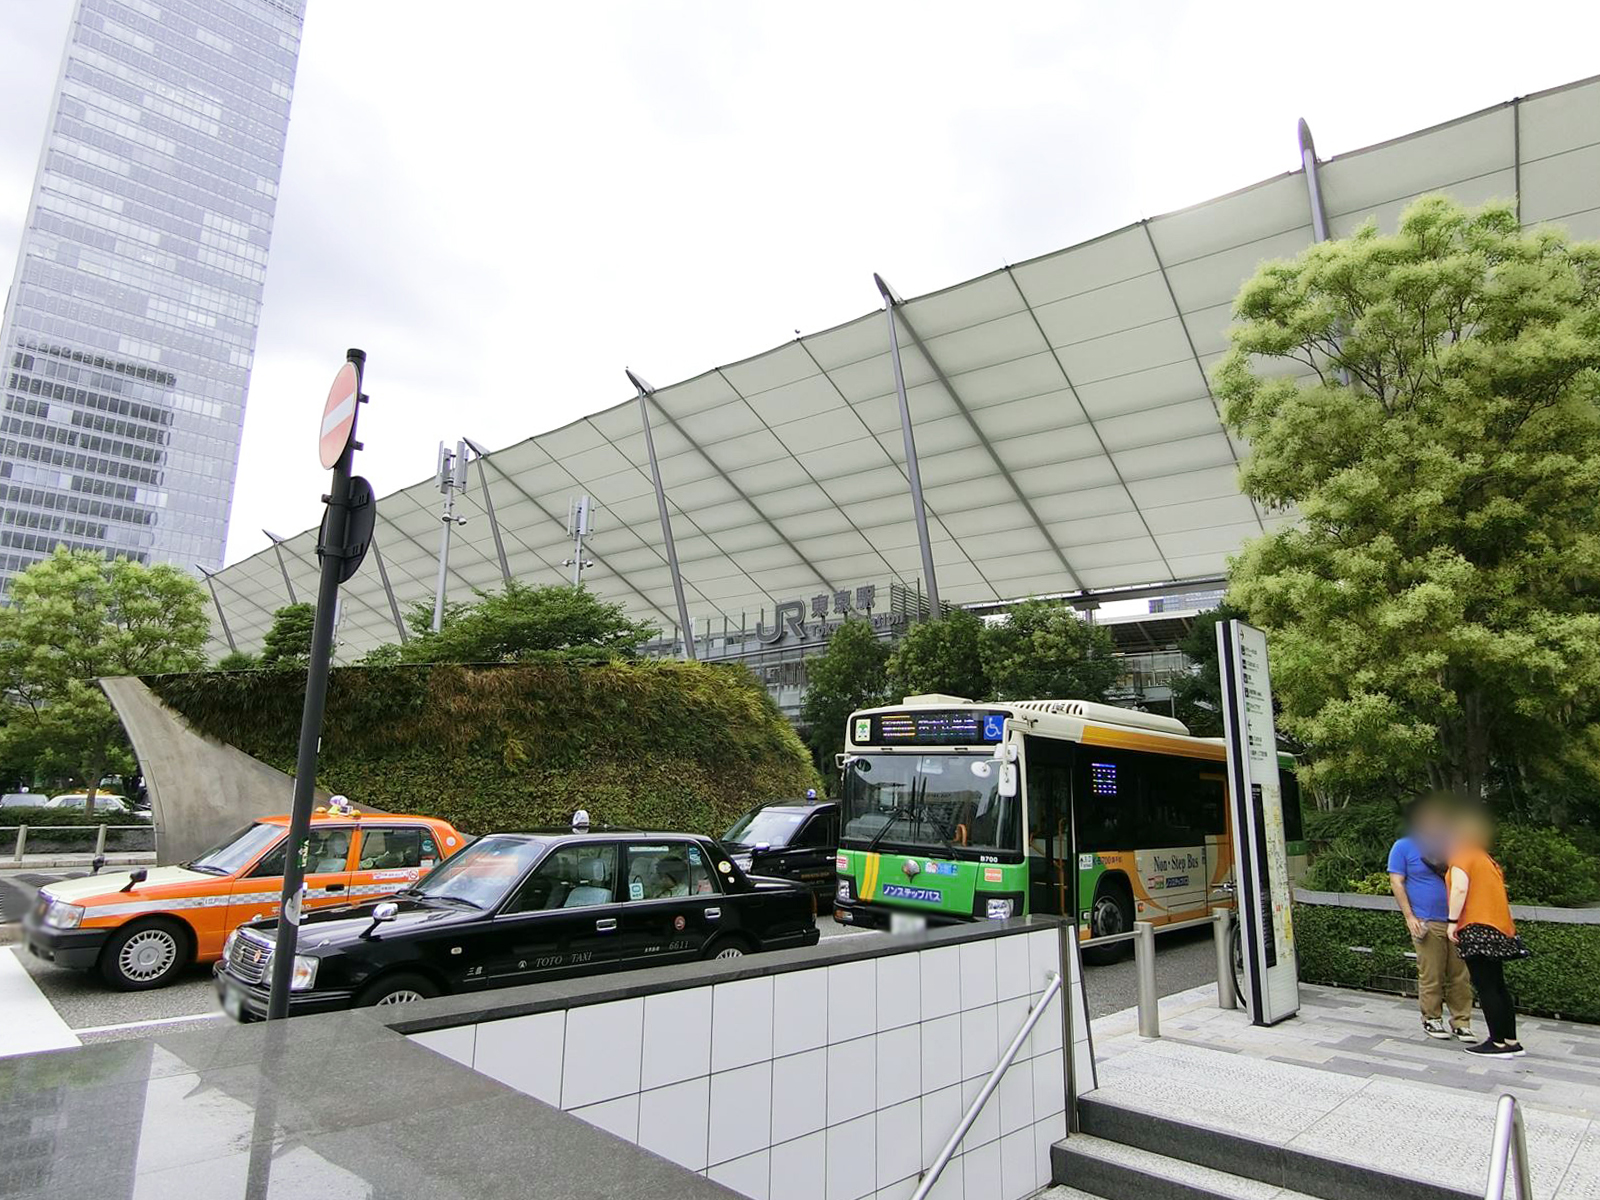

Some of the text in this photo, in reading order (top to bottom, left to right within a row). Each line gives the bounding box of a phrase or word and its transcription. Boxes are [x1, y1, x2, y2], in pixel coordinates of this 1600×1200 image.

[756, 584, 875, 643] JR 東京駅
[980, 855, 998, 863] B700
[1187, 853, 1199, 869] Bus
[883, 884, 941, 901] ノンステップバス
[535, 951, 592, 967] TOTO TAXI
